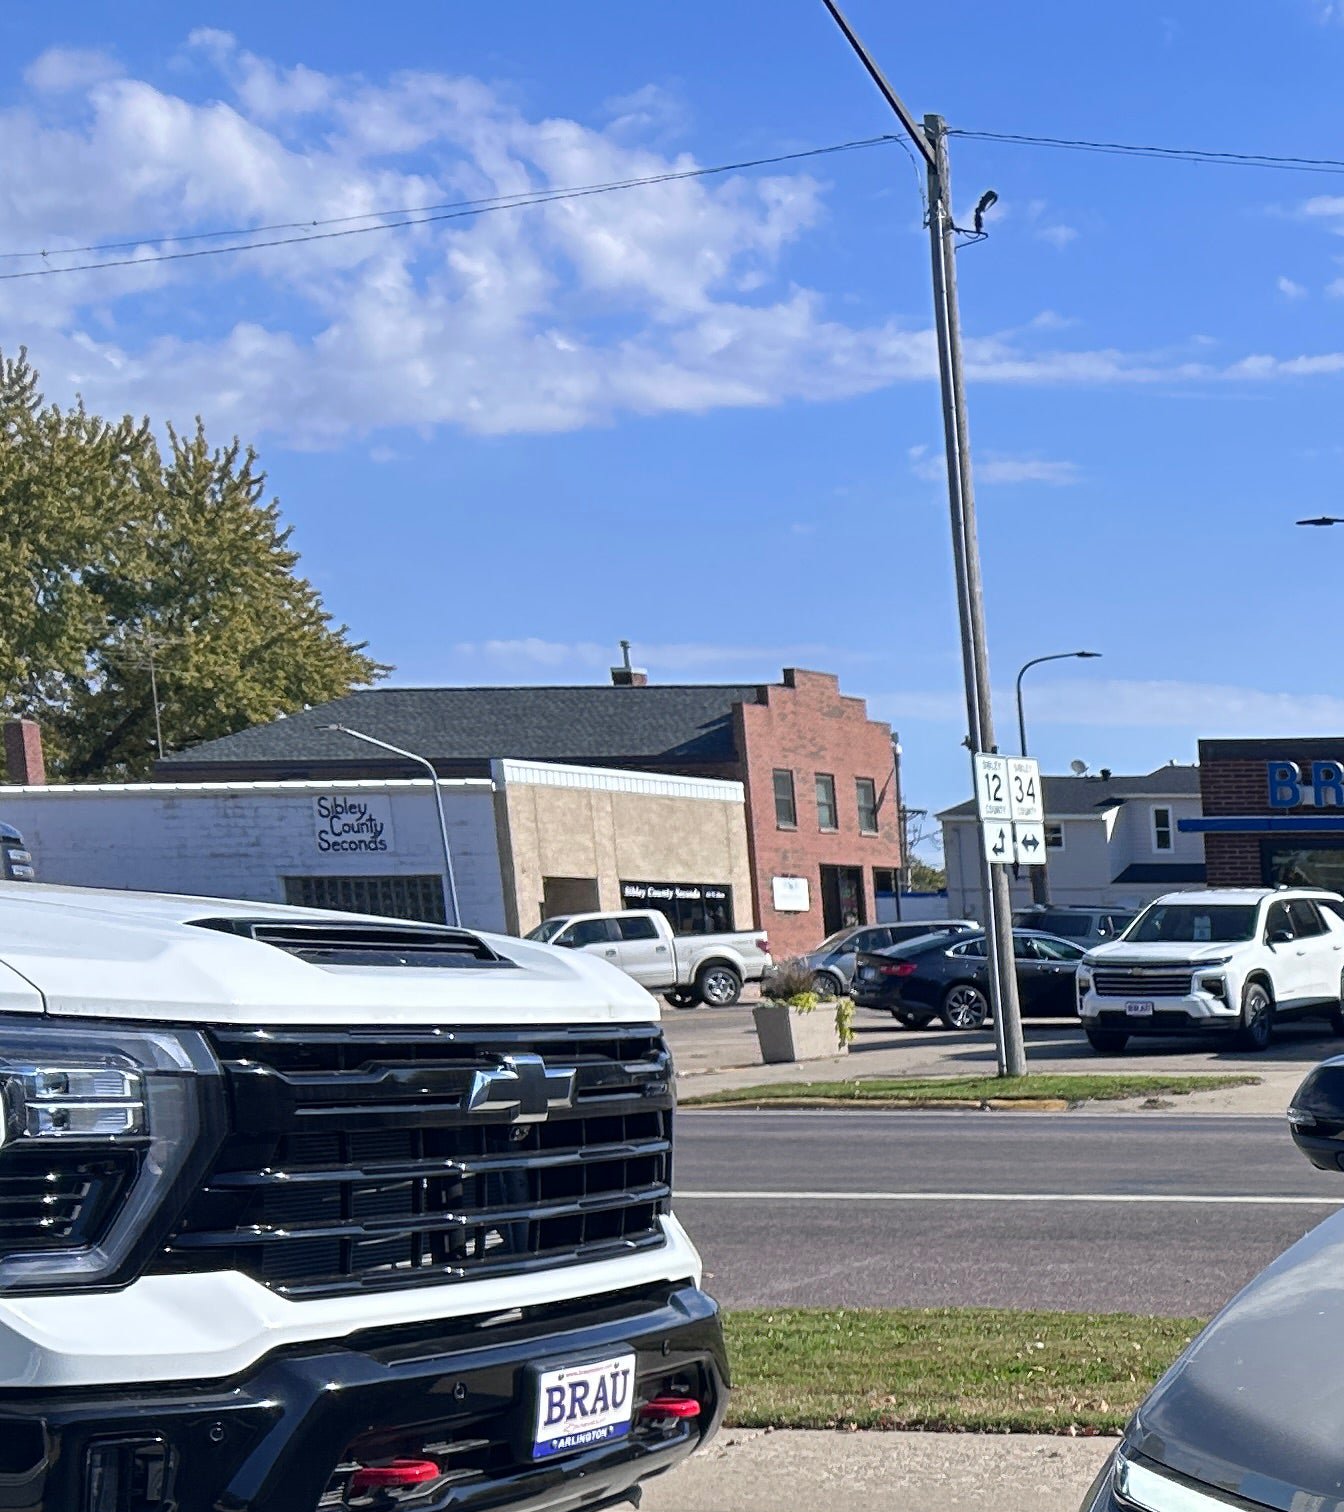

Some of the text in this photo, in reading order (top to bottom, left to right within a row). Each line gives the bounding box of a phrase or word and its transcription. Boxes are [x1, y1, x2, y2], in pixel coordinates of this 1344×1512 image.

[984, 773, 1003, 802] 12
[1014, 775, 1036, 804] 34
[317, 796, 368, 822] Sibley
[329, 813, 384, 838] County
[317, 829, 388, 852] Seconds
[647, 886, 674, 900] County
[544, 1368, 630, 1427] BRAU
[558, 1427, 608, 1448] ARLINGTON
